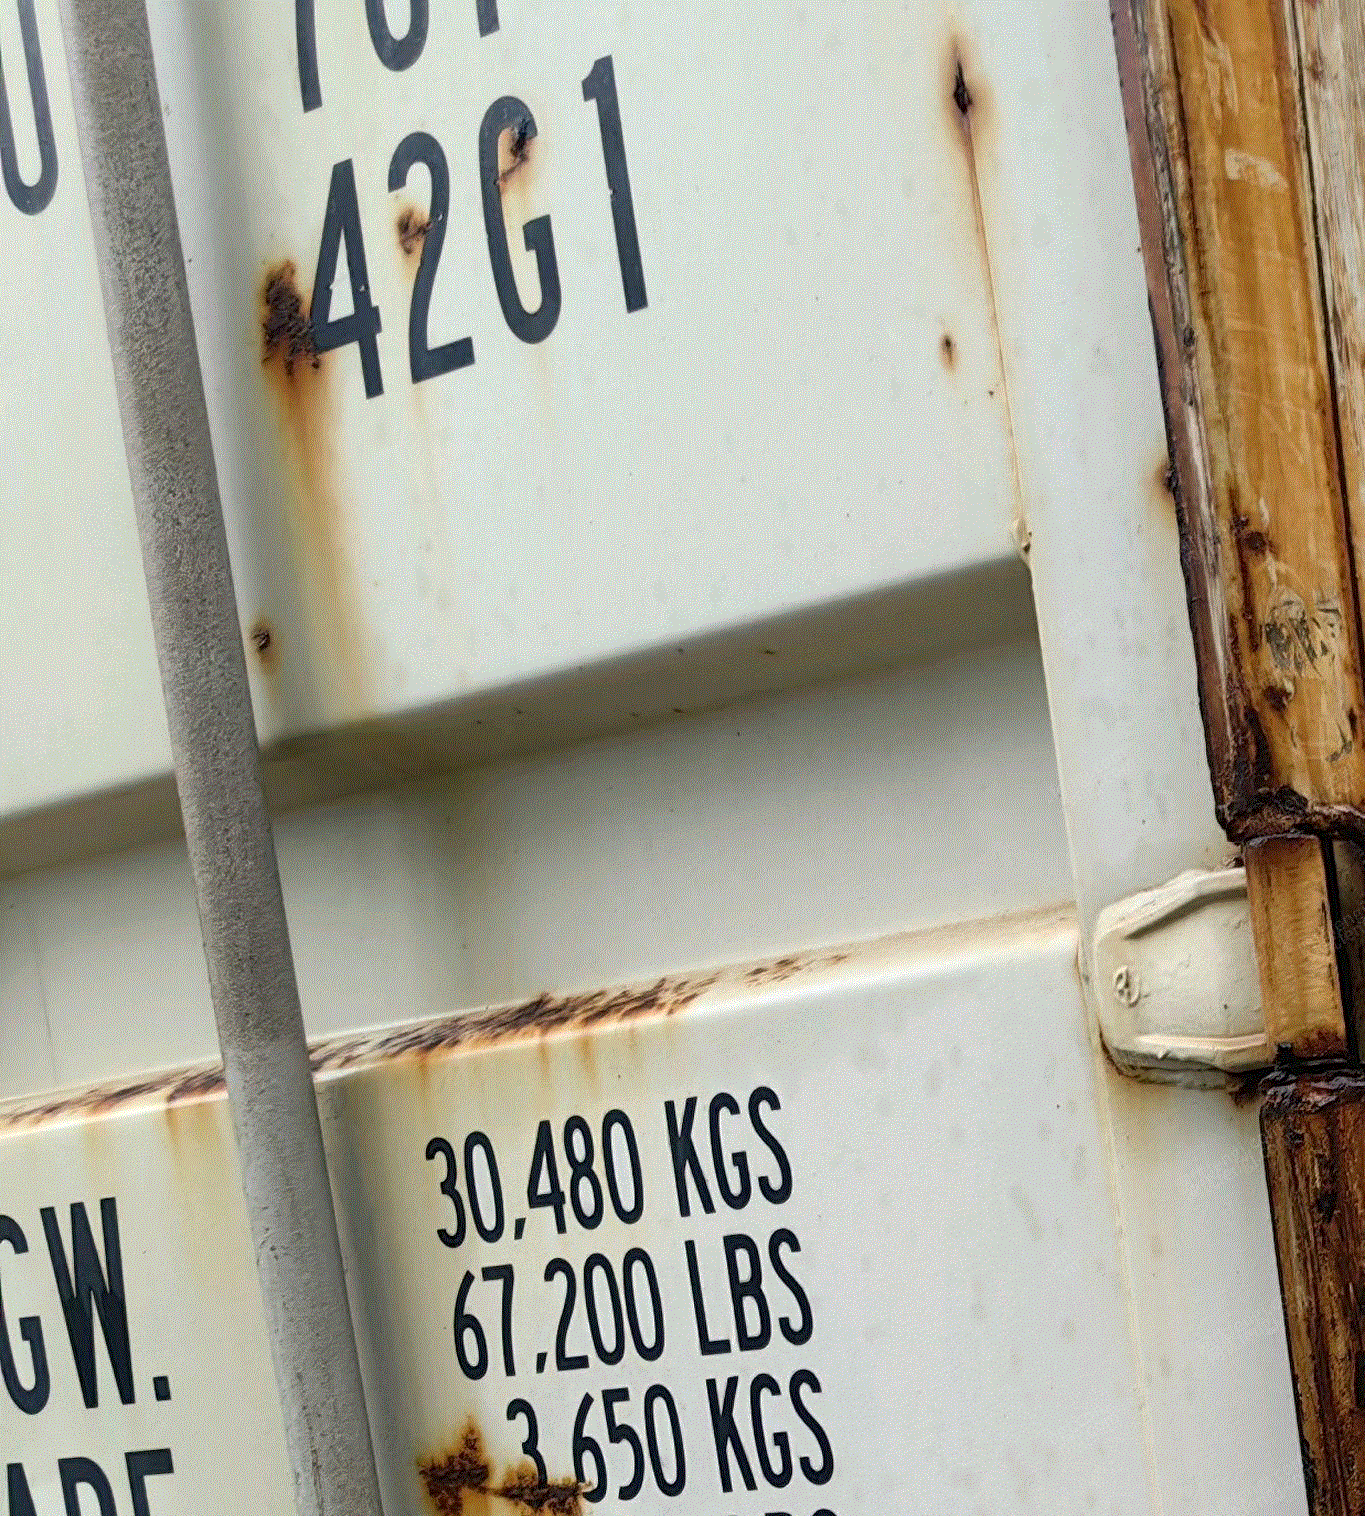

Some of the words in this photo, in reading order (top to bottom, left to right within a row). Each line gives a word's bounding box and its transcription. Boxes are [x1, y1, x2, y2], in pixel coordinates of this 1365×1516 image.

[310, 54, 649, 400] 42G1
[425, 1108, 644, 1249] 30,480
[664, 1086, 793, 1218] KGS
[453, 1247, 666, 1381] 67,200
[684, 1227, 814, 1356] LBS
[506, 1383, 687, 1502] 3650
[705, 1368, 835, 1495] KGS
